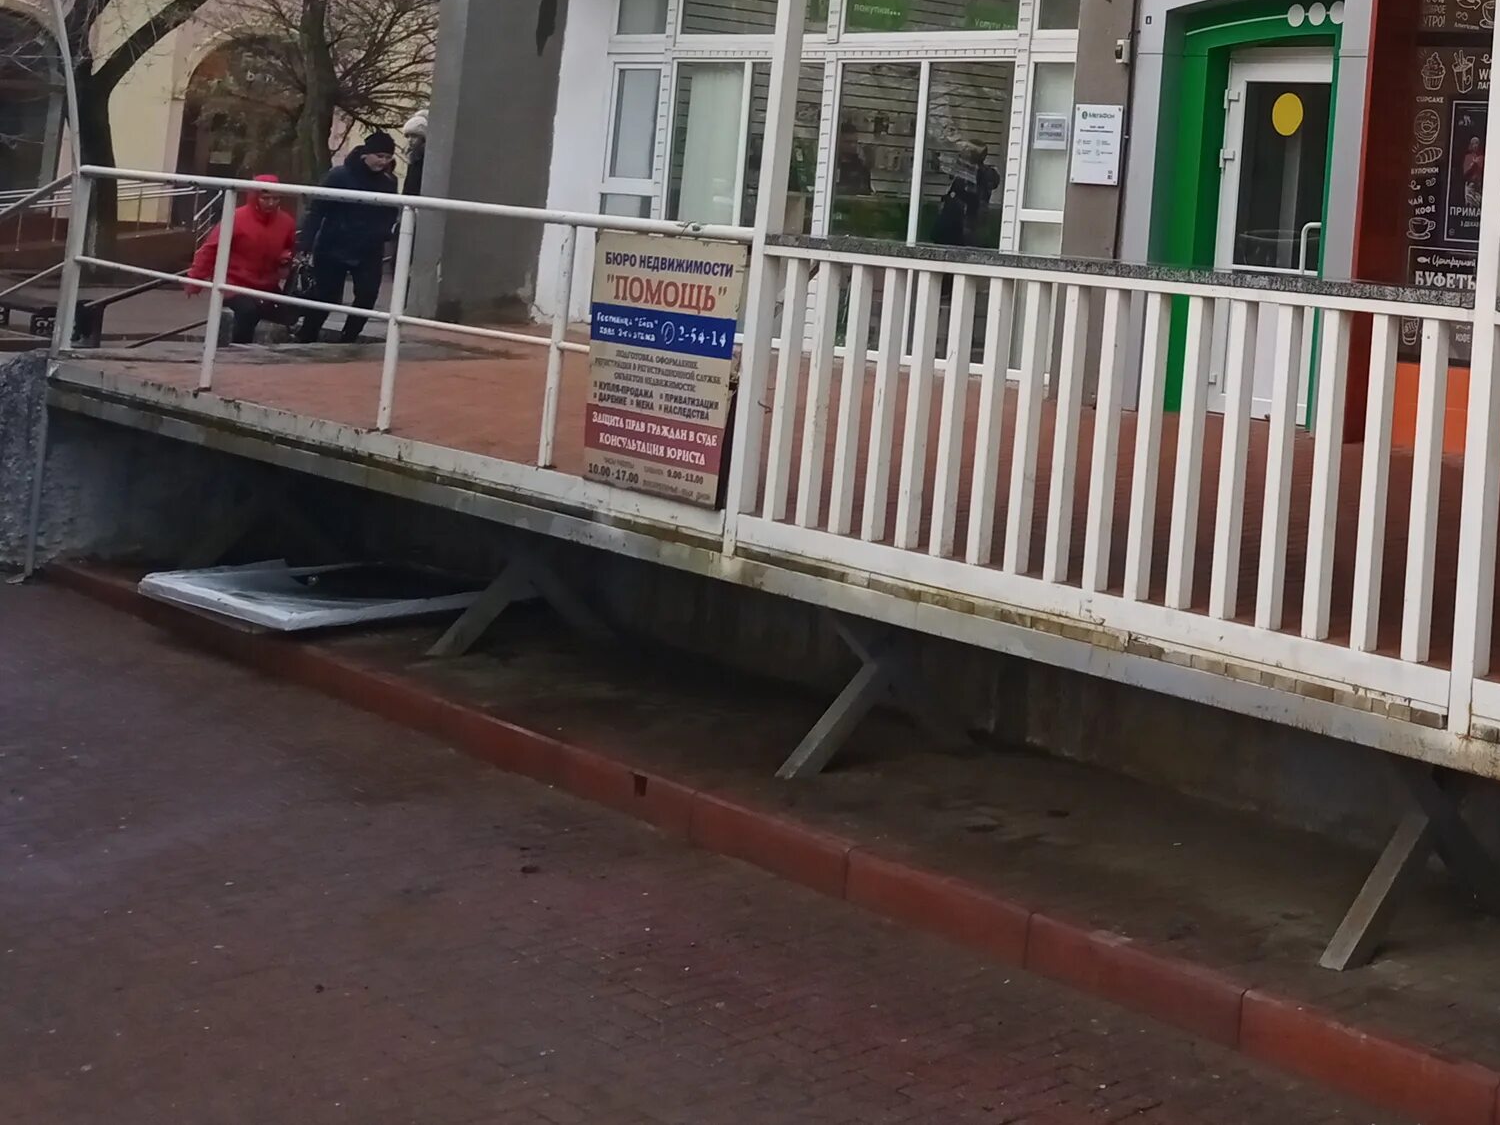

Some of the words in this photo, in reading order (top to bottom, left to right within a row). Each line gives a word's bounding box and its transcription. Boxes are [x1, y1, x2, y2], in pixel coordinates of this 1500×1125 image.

[1416, 96, 1444, 104] CUPCAKE
[1408, 196, 1424, 206] ЧАЙ
[1415, 205, 1436, 215] КОФЕ
[605, 251, 637, 268] БЮРО
[639, 254, 734, 278] НЕДВИЖИМОСТИ
[598, 381, 654, 400] КУПЛЯ-ПРОДАЖА
[598, 392, 628, 406] ДАРЕНИЕ
[635, 399, 654, 411] МЕНА
[664, 393, 720, 411] ПРИВАТИЗАЦИЯ
[663, 404, 710, 421] НАСЛЕДСТВА
[592, 411, 625, 429] ЗАЩИТА
[625, 418, 646, 432] ПРАВ
[646, 422, 687, 441] ГРАЖДАН
[695, 430, 718, 447] СУДЕ
[598, 432, 665, 458] КОНСУЛЬТАЦИЯ
[666, 448, 706, 466] ЮРИСТА
